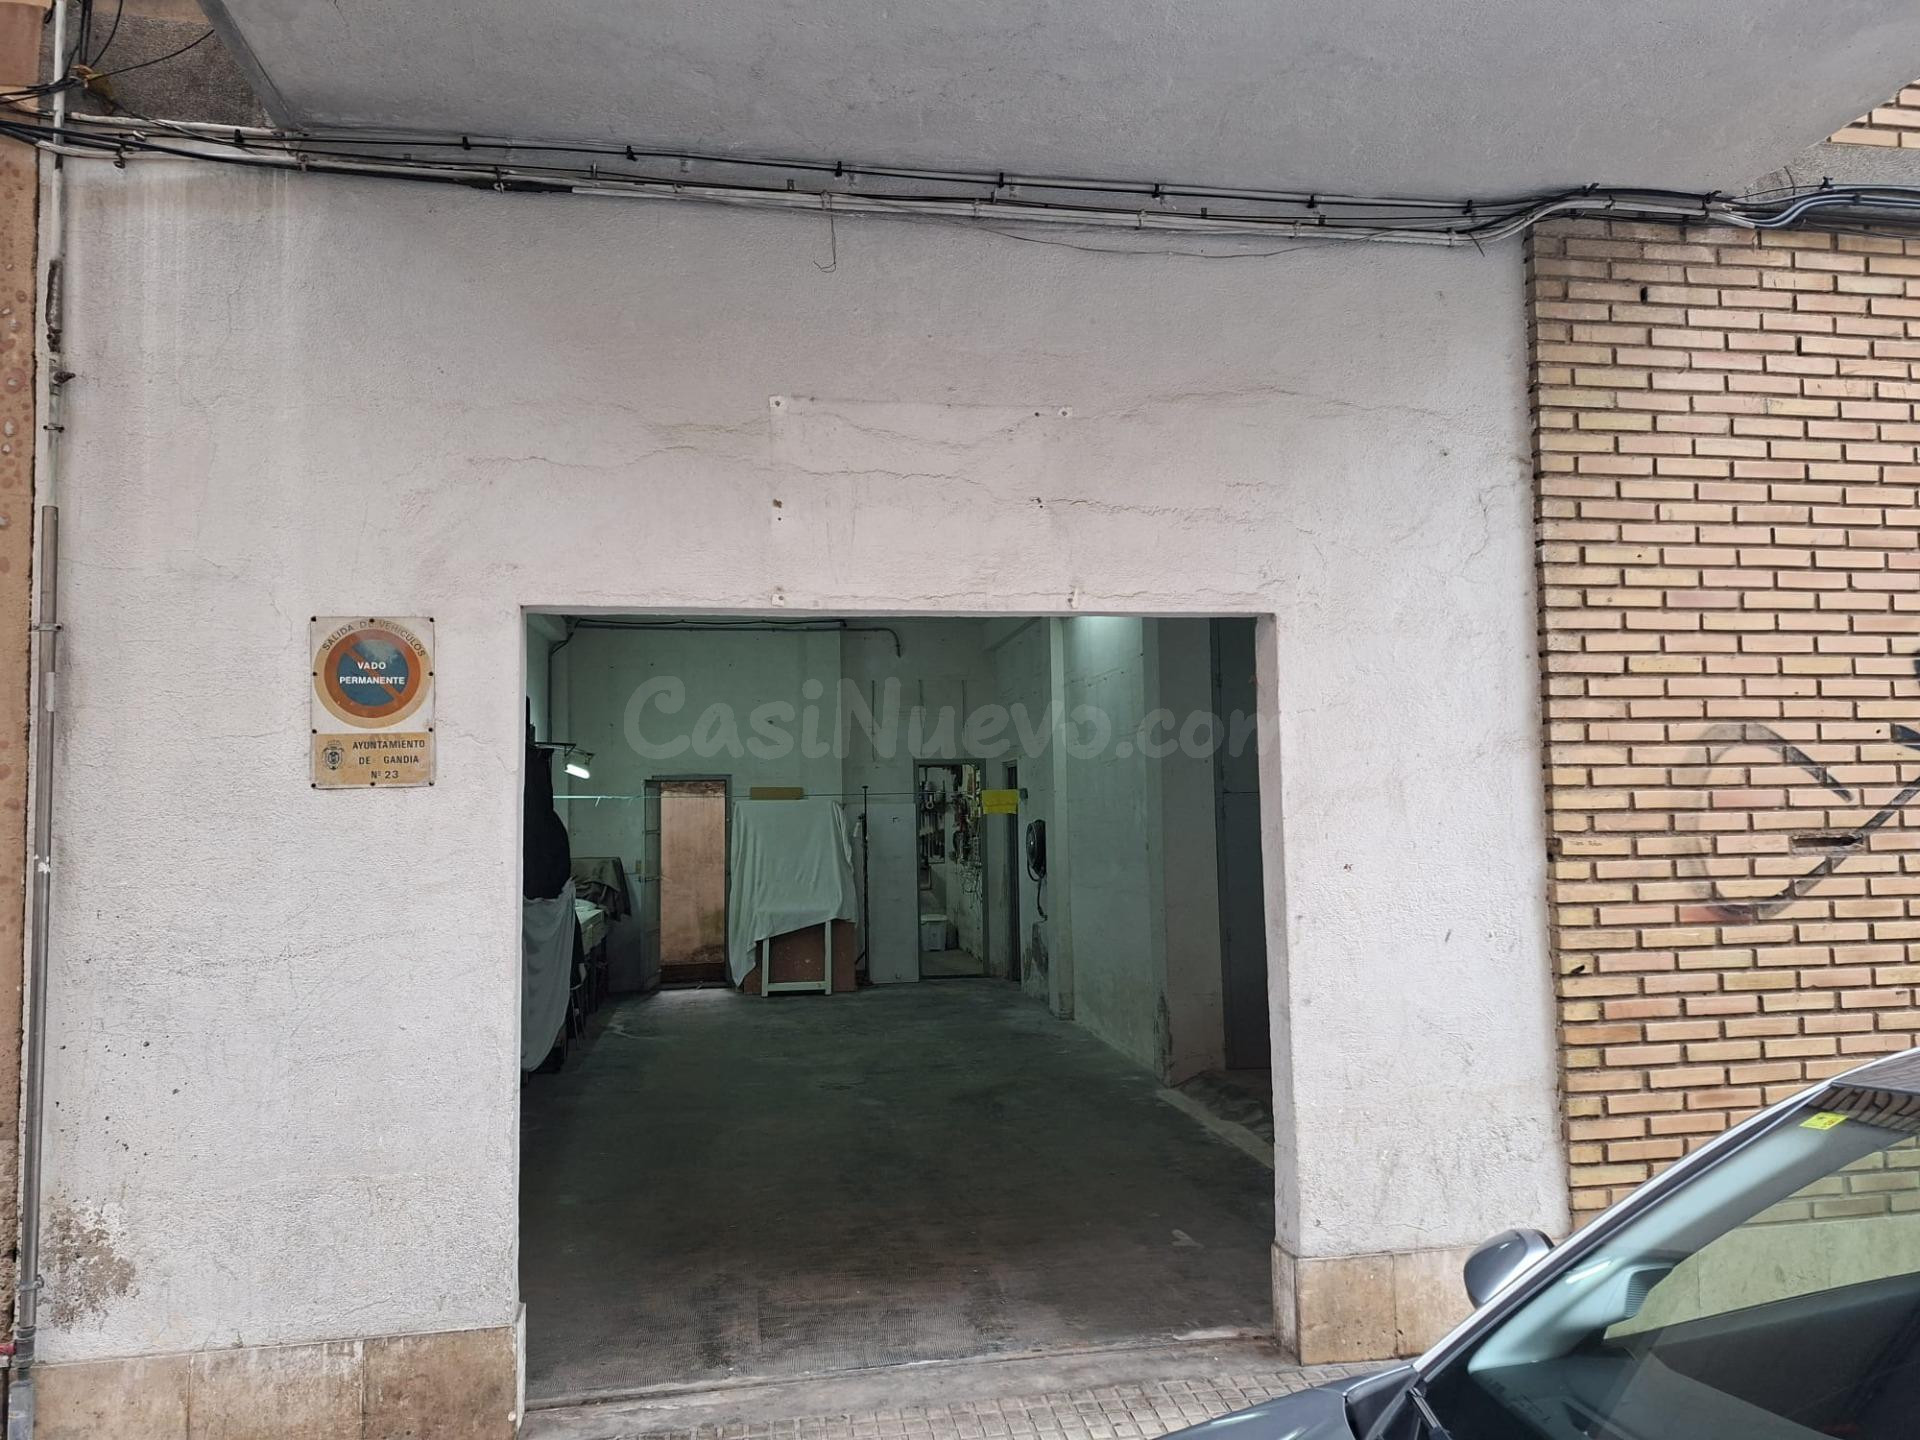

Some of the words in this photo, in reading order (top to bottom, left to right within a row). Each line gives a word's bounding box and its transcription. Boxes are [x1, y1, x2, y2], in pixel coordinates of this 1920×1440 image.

[322, 624, 355, 651] SALIDA
[380, 621, 426, 657] VEHICULOS
[357, 661, 386, 670] VADO
[339, 676, 405, 685] PERMANENTE
[352, 740, 425, 749] AYUNTAMIENTO
[358, 757, 371, 765] DE
[383, 755, 419, 764] GANDIA
[384, 770, 399, 779] 23
